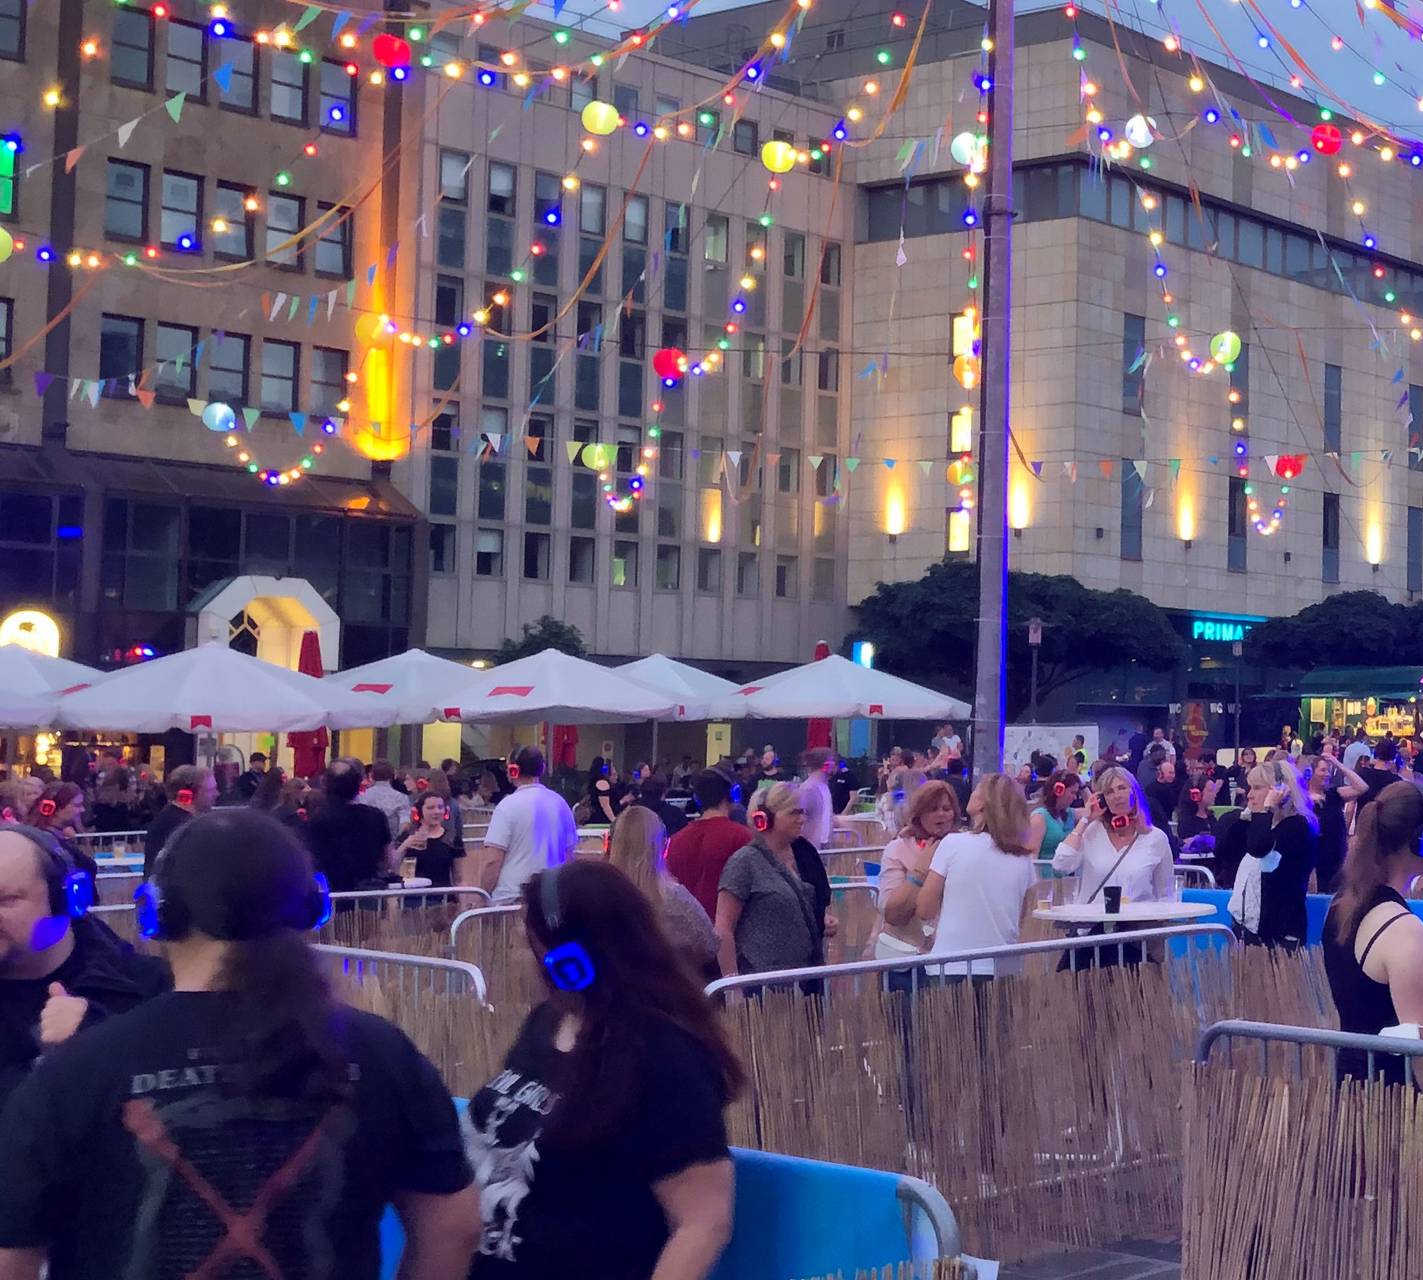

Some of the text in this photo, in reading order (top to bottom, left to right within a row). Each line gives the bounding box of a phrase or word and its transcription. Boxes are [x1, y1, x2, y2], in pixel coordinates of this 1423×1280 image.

[1193, 621, 1252, 641] PRIMA
[1169, 703, 1182, 714] WC
[131, 1064, 219, 1094] DEAT
